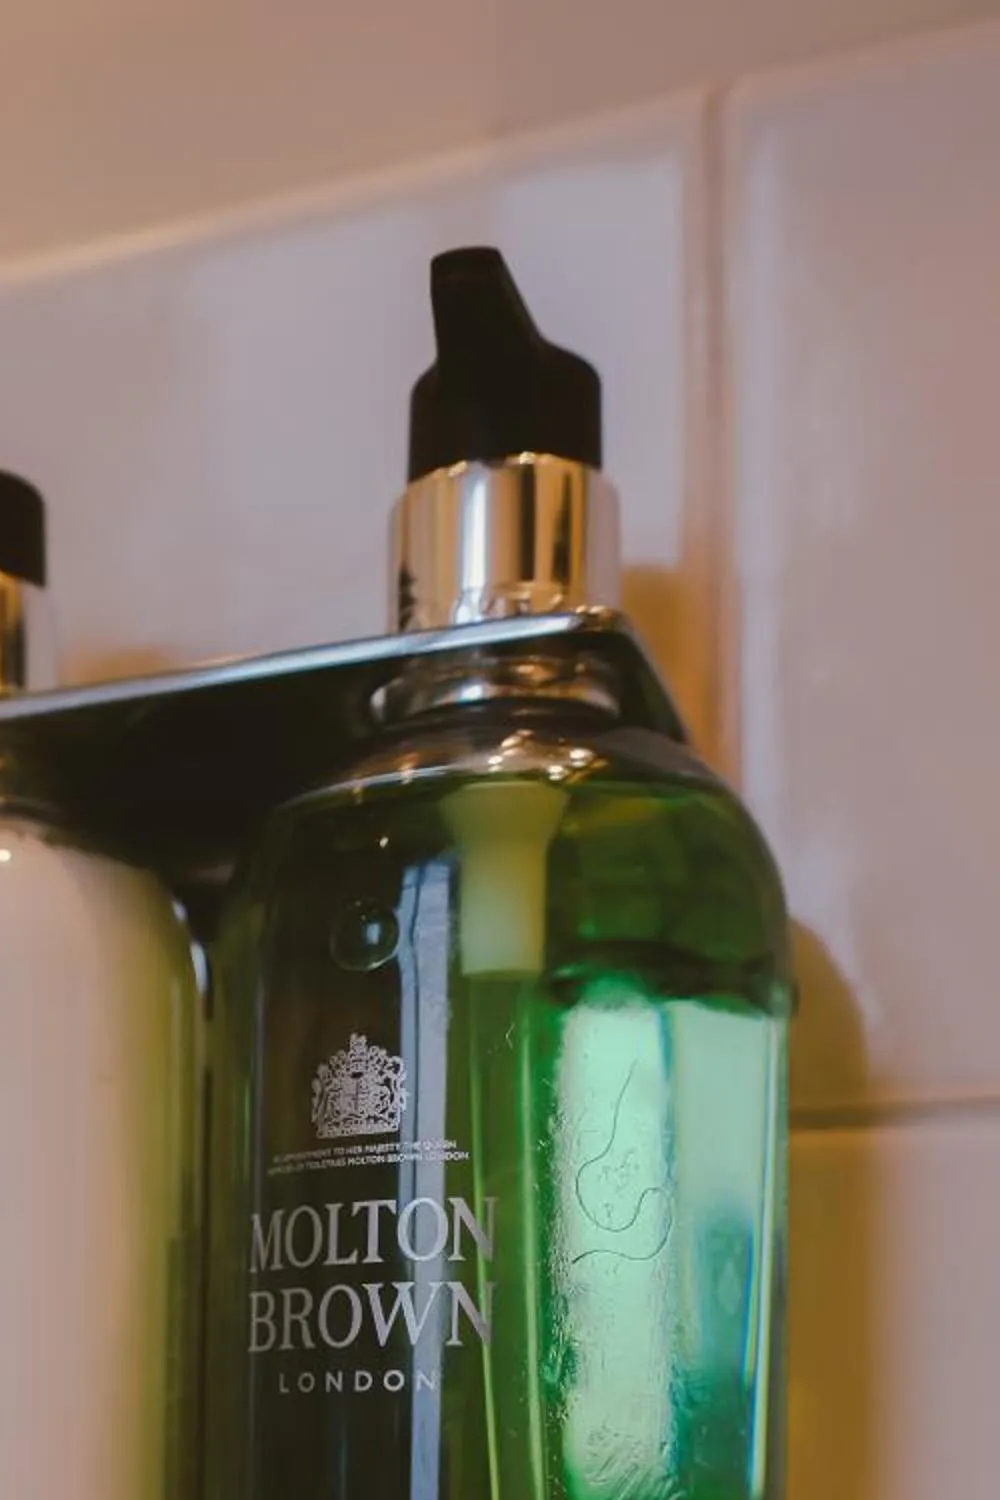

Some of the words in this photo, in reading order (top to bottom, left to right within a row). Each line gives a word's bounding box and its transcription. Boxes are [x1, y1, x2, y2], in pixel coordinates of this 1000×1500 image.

[249, 1196, 497, 1274] MOLTON
[248, 1281, 497, 1353] BROWN
[279, 1369, 438, 1394] LONDON
